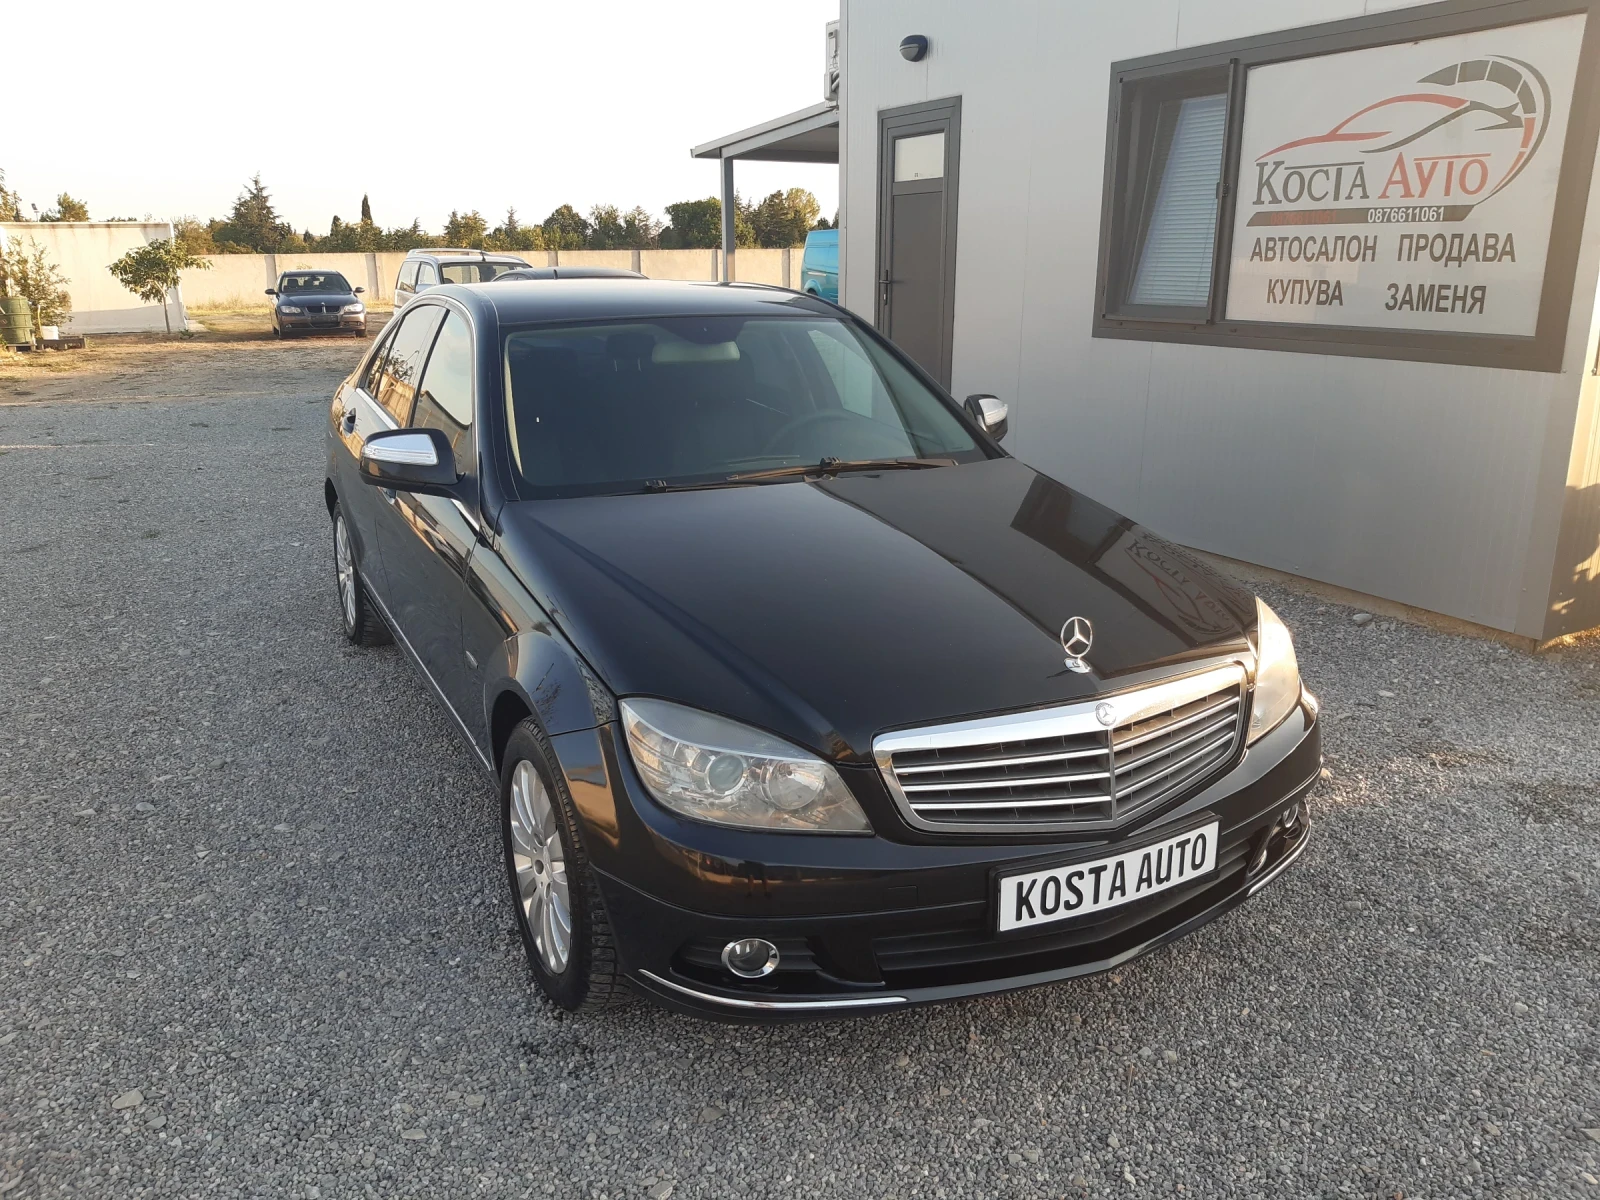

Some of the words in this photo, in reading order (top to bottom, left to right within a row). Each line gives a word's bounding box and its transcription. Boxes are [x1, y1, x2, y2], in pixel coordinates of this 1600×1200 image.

[1367, 206, 1445, 223] 0876611061
[1250, 235, 1378, 263] АВТОСАЛОН
[1396, 232, 1517, 268] ПРОДАВА
[1266, 278, 1344, 306] КУПУВА
[1385, 283, 1487, 315] ЗАМЕНЯ
[1015, 859, 1127, 922] KOSTA
[1135, 832, 1207, 893] AUTO
